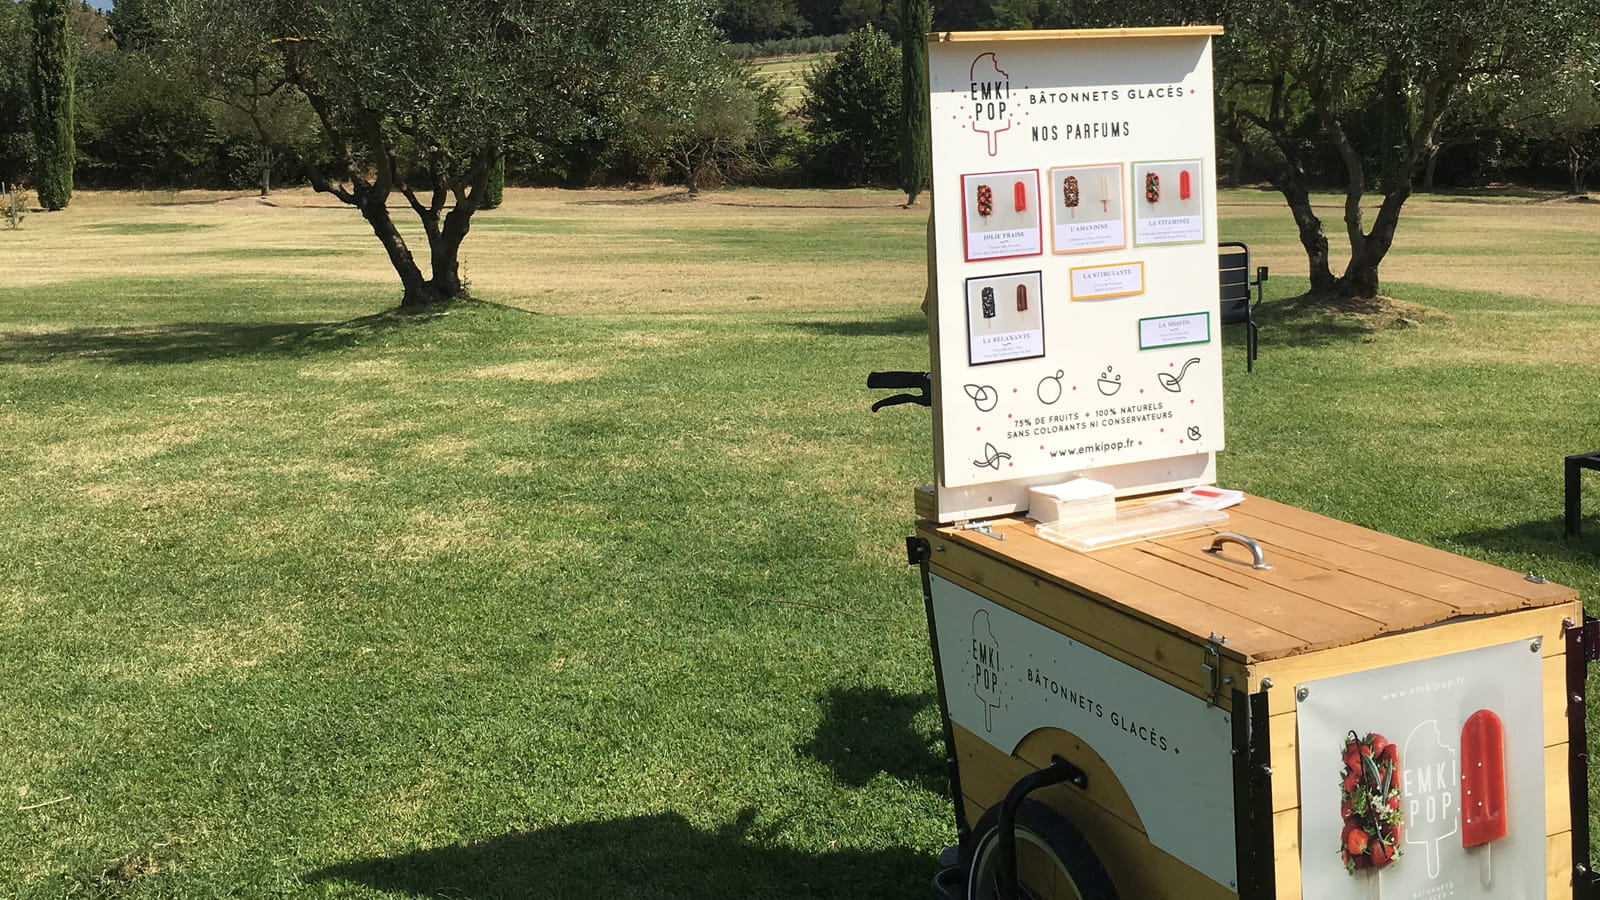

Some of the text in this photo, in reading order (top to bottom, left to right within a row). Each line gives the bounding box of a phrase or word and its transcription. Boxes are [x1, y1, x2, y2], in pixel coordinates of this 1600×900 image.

[970, 81, 1010, 101] EMKI
[1030, 85, 1184, 105] BÂTONNETS GLACÉS
[975, 102, 1007, 121] POP
[1031, 121, 1130, 142] NOS PARFUMS
[1003, 231, 1025, 239] FRAISE
[1070, 224, 1109, 232] L'AMANDINE
[993, 333, 1031, 343] RELAXANTE
[1007, 410, 1173, 439] SANS COLORANTS NI CONSERVATEURS
[1014, 401, 1163, 427] 75% DE FRUITS 100% NATURELS
[1049, 437, 1134, 458] www.emkipop.fr
[972, 639, 1000, 672] EMKI
[975, 663, 998, 694] POP
[1027, 668, 1168, 752] BÂTONNETS GLACÉS
[1403, 759, 1457, 798] EMKI
[1410, 791, 1452, 828] POP
